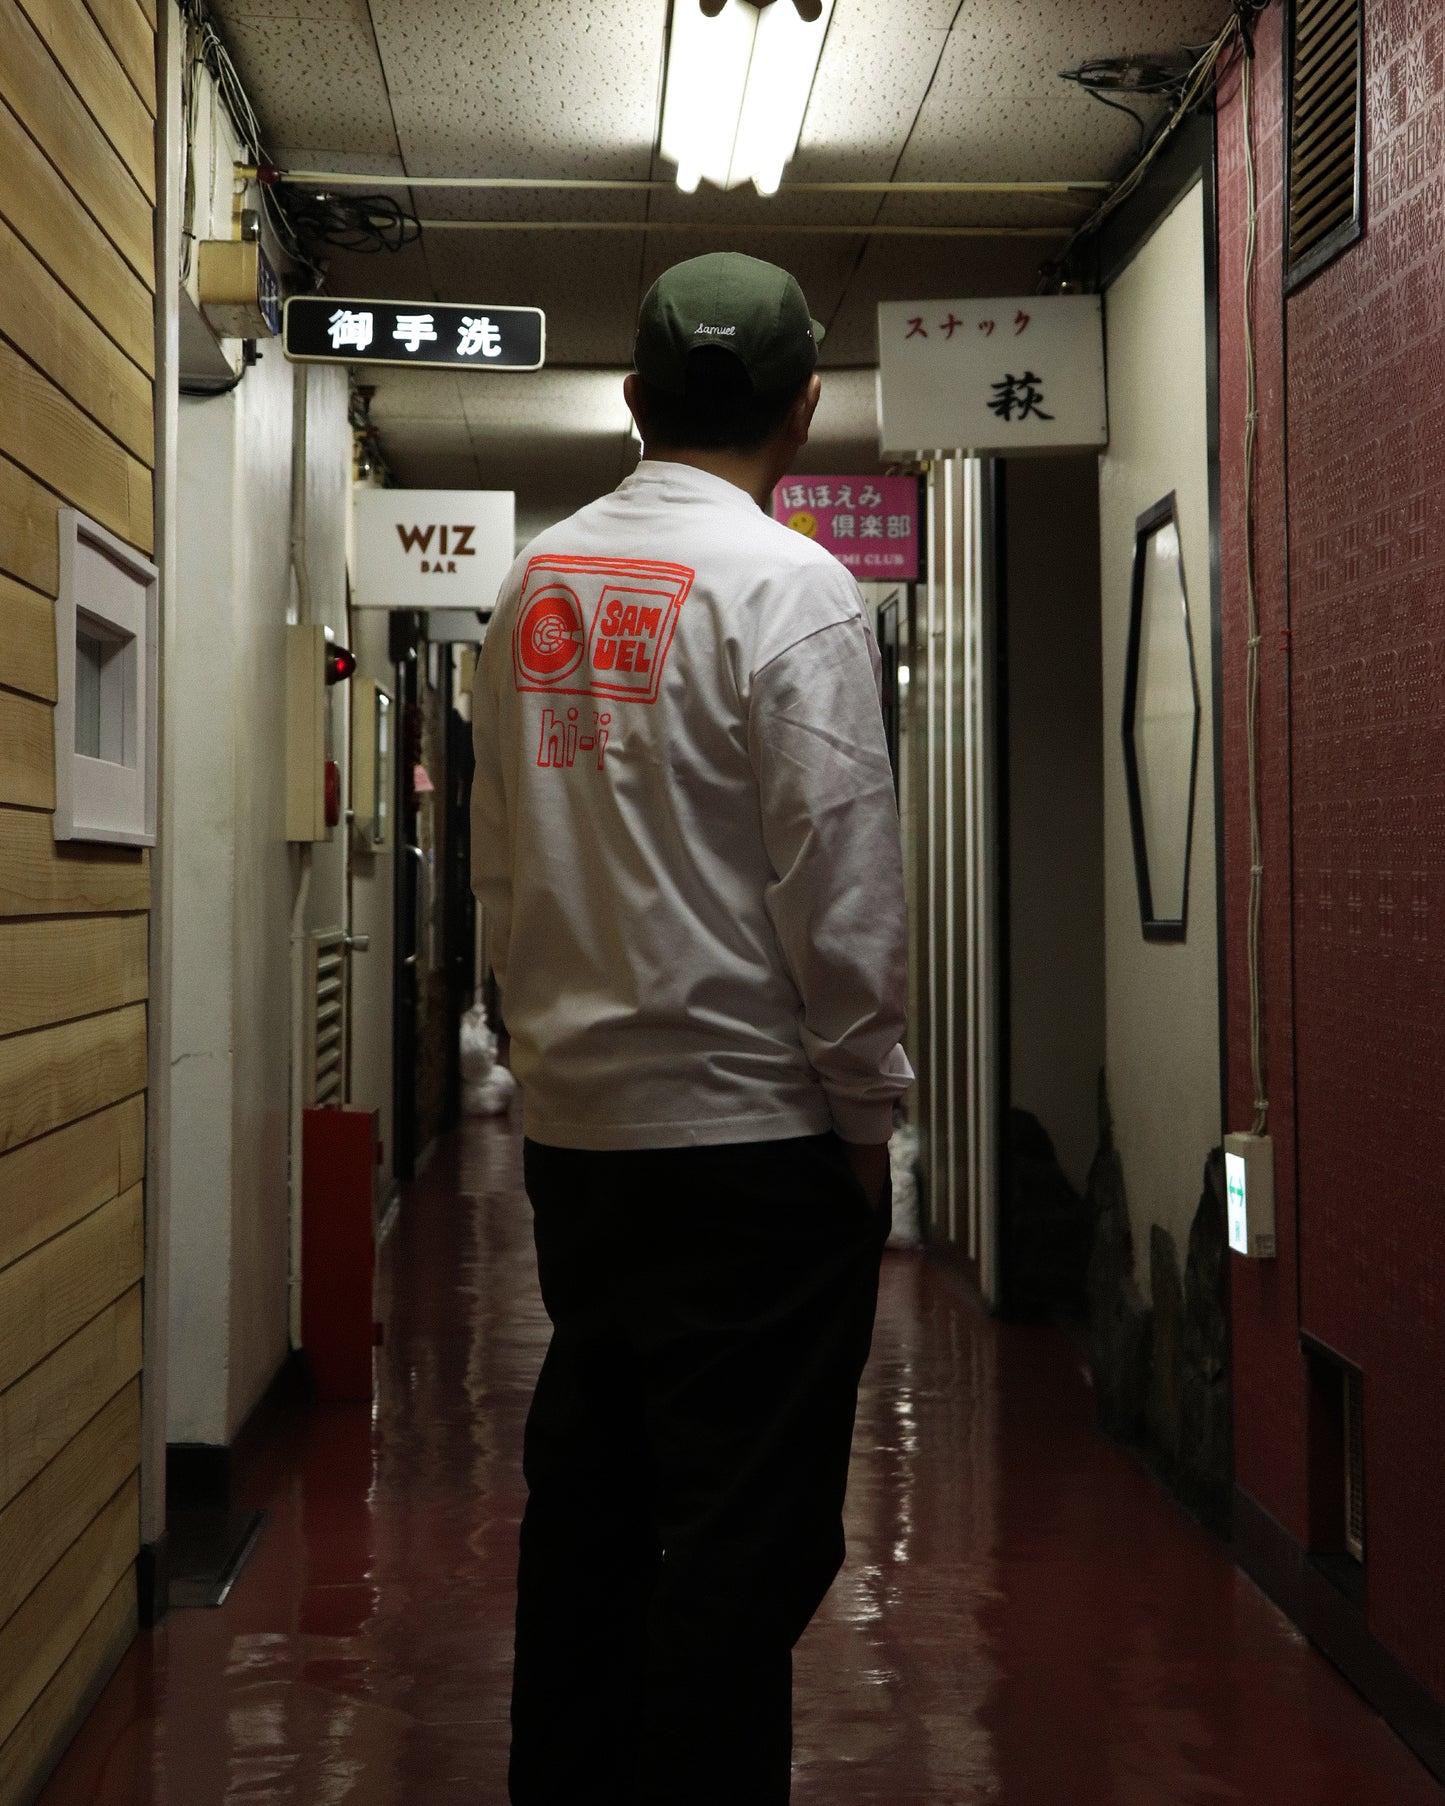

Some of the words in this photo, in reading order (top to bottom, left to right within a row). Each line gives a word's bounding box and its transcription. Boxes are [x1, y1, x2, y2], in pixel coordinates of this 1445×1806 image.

[327, 309, 502, 357] 御手洗
[694, 323, 736, 336] Samuel
[905, 310, 1031, 340] スナック
[986, 370, 1056, 422] 萩
[781, 484, 882, 509] ほほえみ
[395, 524, 476, 555] WIZ
[831, 514, 911, 538] 倶楽部
[420, 560, 457, 574] BAR
[864, 553, 904, 566] CLUB
[600, 599, 662, 639] SAM
[592, 637, 651, 673] UEL
[536, 707, 611, 771] hi-i
